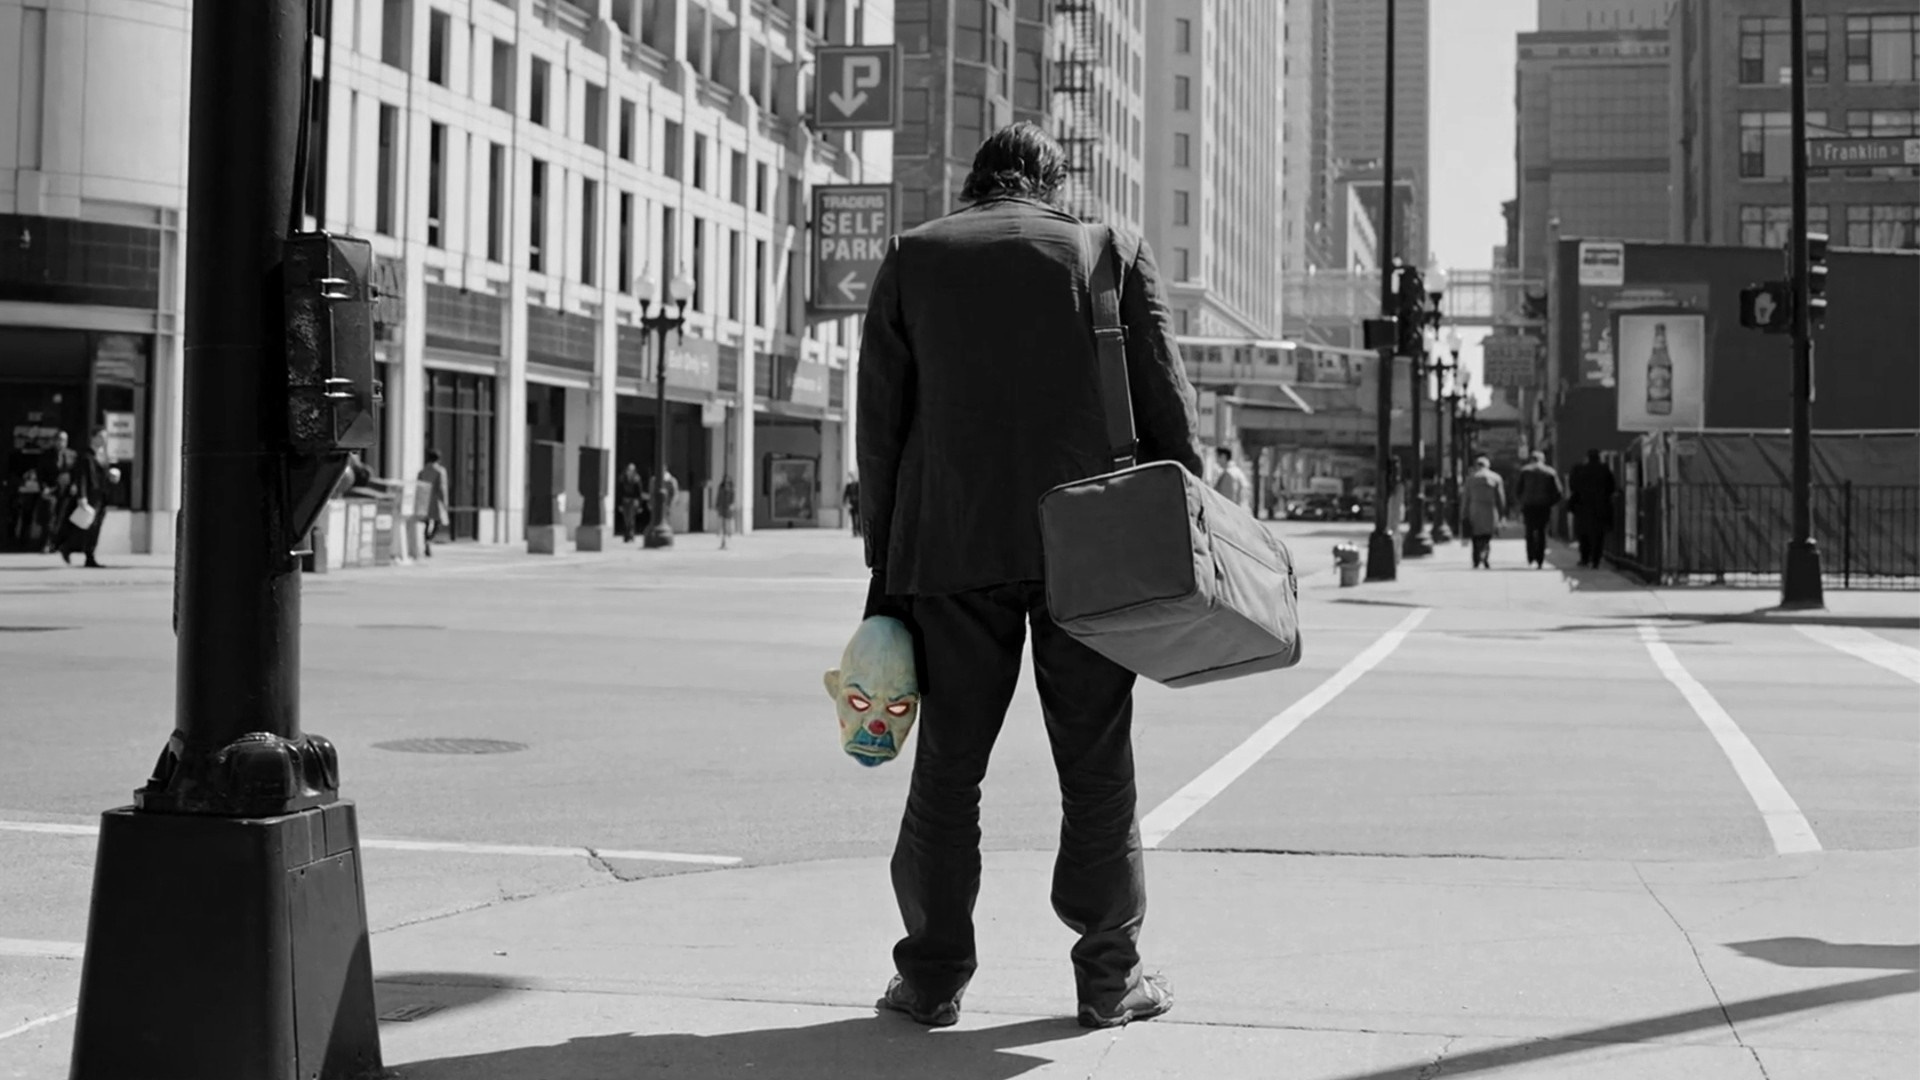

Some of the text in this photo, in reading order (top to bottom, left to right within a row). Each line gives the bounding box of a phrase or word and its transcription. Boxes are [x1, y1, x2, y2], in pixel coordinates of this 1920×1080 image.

[1824, 143, 1887, 160] Franklin
[822, 196, 884, 208] TRADERS
[821, 212, 884, 234] SELF
[820, 238, 884, 260] PARK
